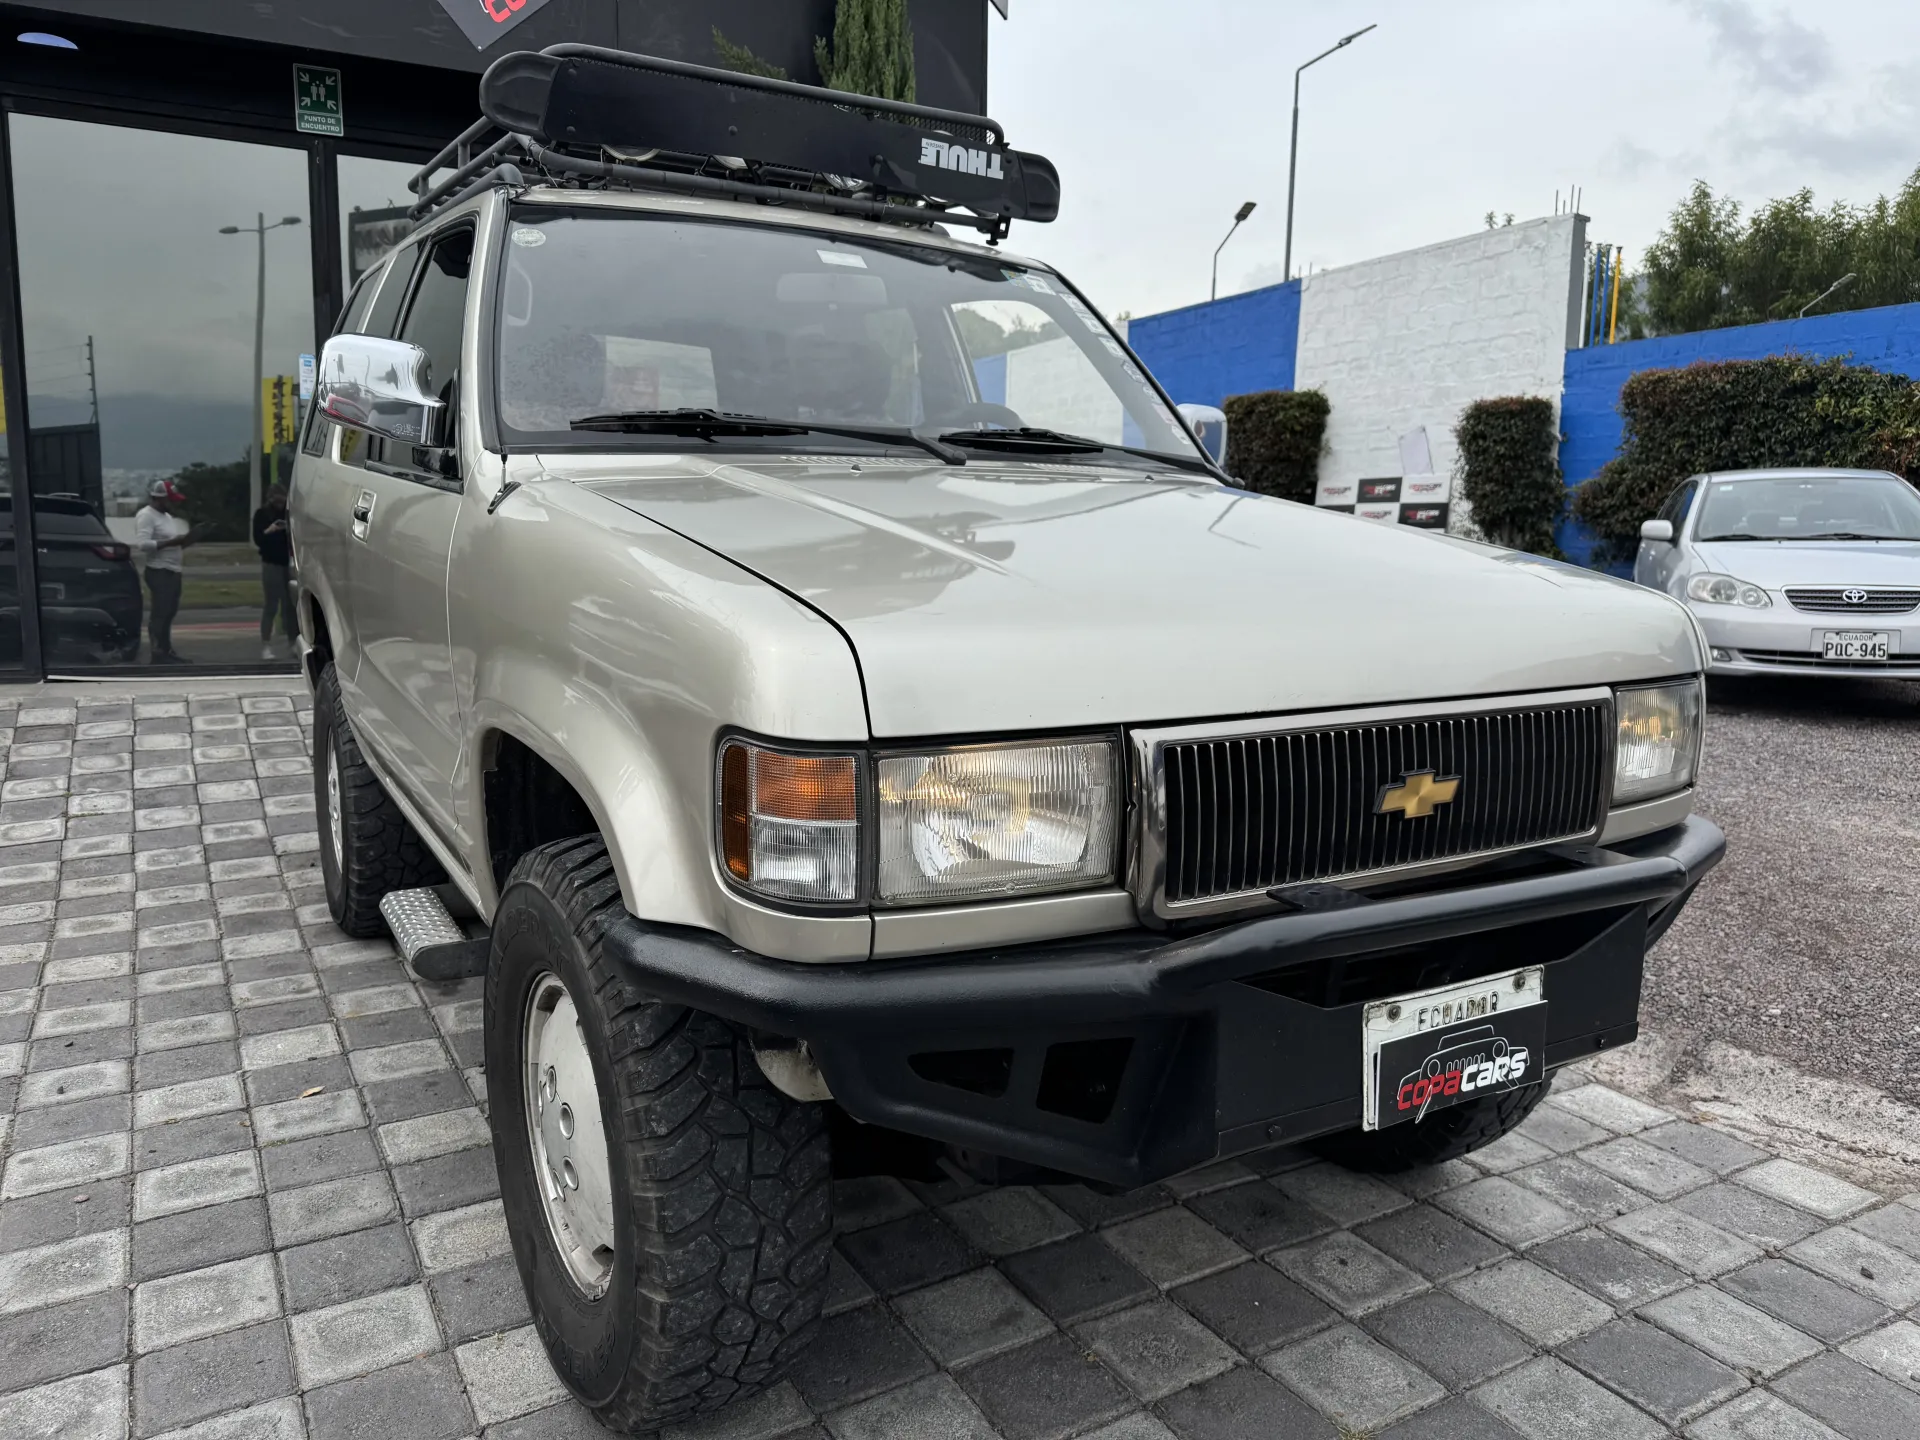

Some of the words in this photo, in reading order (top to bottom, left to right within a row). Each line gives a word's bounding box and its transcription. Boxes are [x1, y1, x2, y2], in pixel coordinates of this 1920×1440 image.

[304, 115, 326, 123] PUNTO
[301, 122, 340, 132] ENCUENTRO
[920, 138, 1004, 180] THULE
[1839, 633, 1874, 642] ECUADOR
[1824, 642, 1886, 658] PQC-945
[1418, 991, 1499, 1032] ECUADOR
